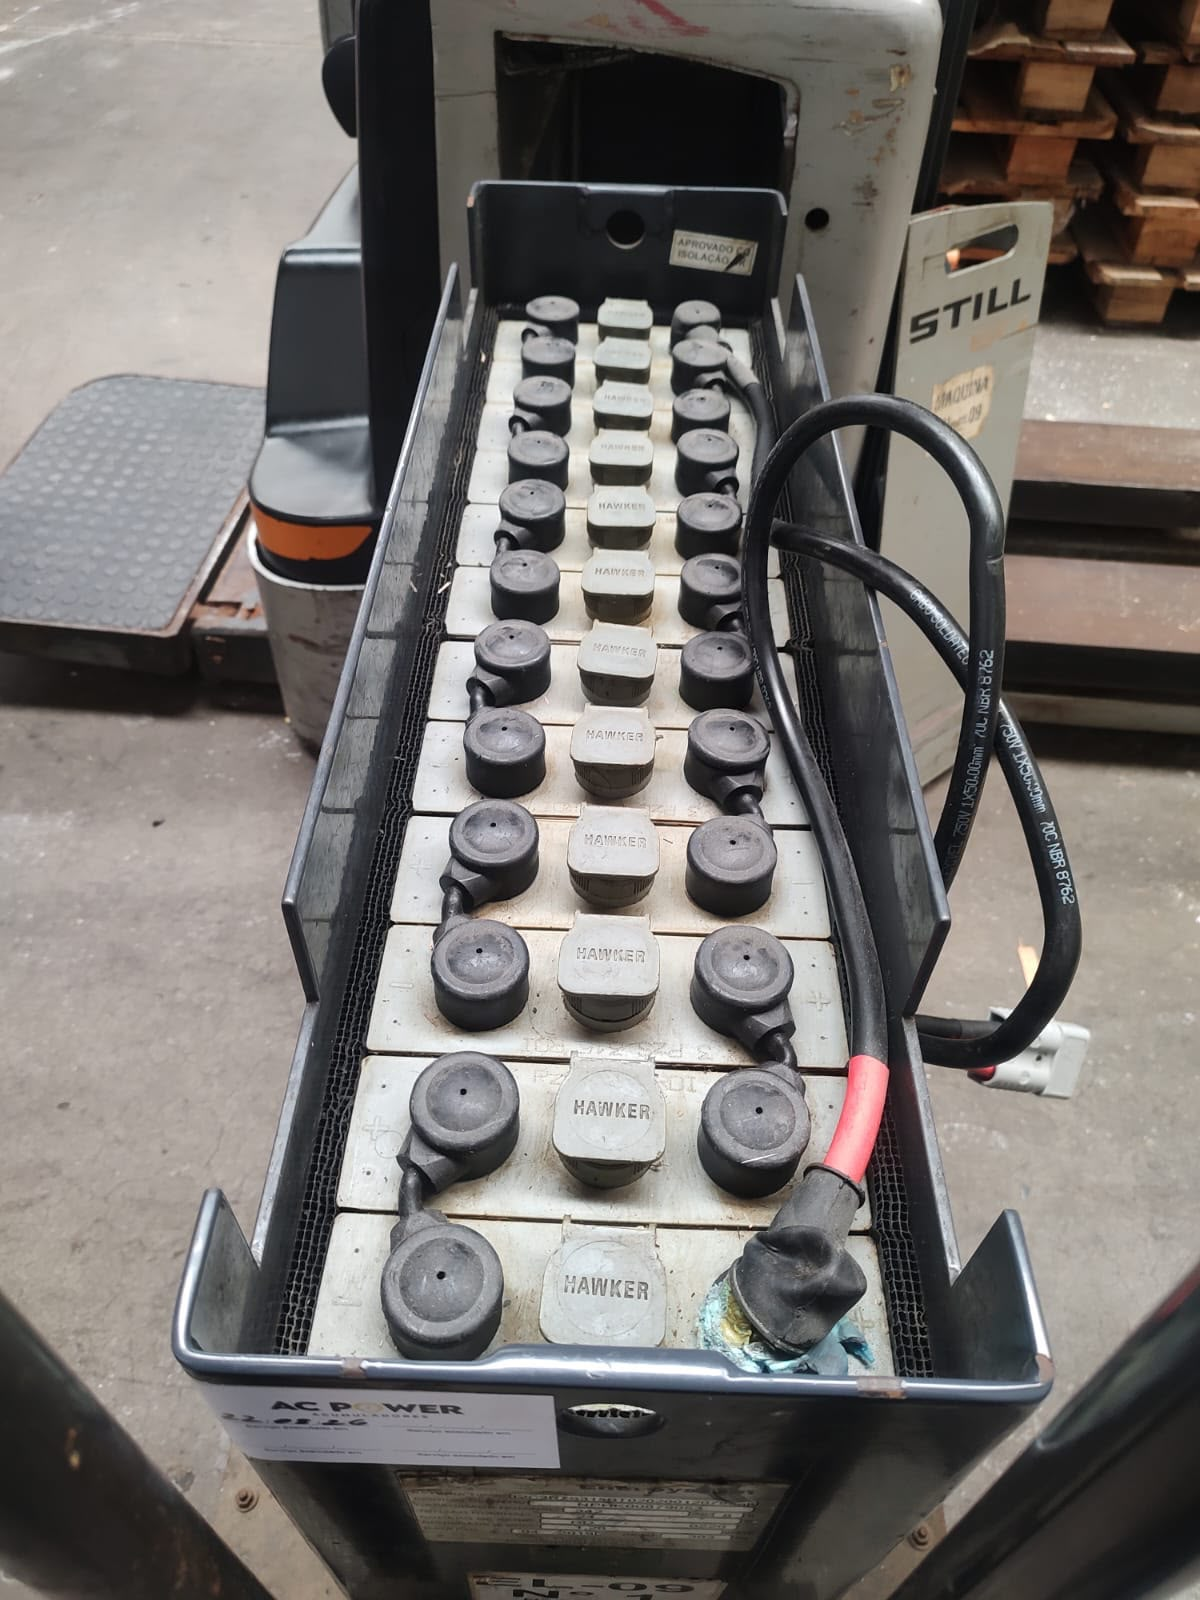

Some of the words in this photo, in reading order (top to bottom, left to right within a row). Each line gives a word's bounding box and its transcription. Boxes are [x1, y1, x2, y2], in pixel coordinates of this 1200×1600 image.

[678, 238, 734, 254] APROVADO
[909, 278, 1032, 344] STILL
[600, 443, 645, 451] HAWKER
[598, 502, 646, 511] HAWKER
[594, 567, 646, 577] HAWKER
[592, 642, 648, 658] HAWKER
[979, 649, 994, 686] 8762
[585, 728, 645, 742] HAWKER
[1039, 820, 1058, 842] 70C
[583, 833, 648, 849] HAWKER
[1046, 842, 1066, 870] NBR
[1056, 870, 1076, 905] 8762
[576, 946, 646, 963] HAWKER
[573, 1099, 651, 1120] HAWKER
[563, 1274, 650, 1301] HAWKER
[271, 1400, 320, 1411] AC
[329, 1402, 464, 1415] POWER
